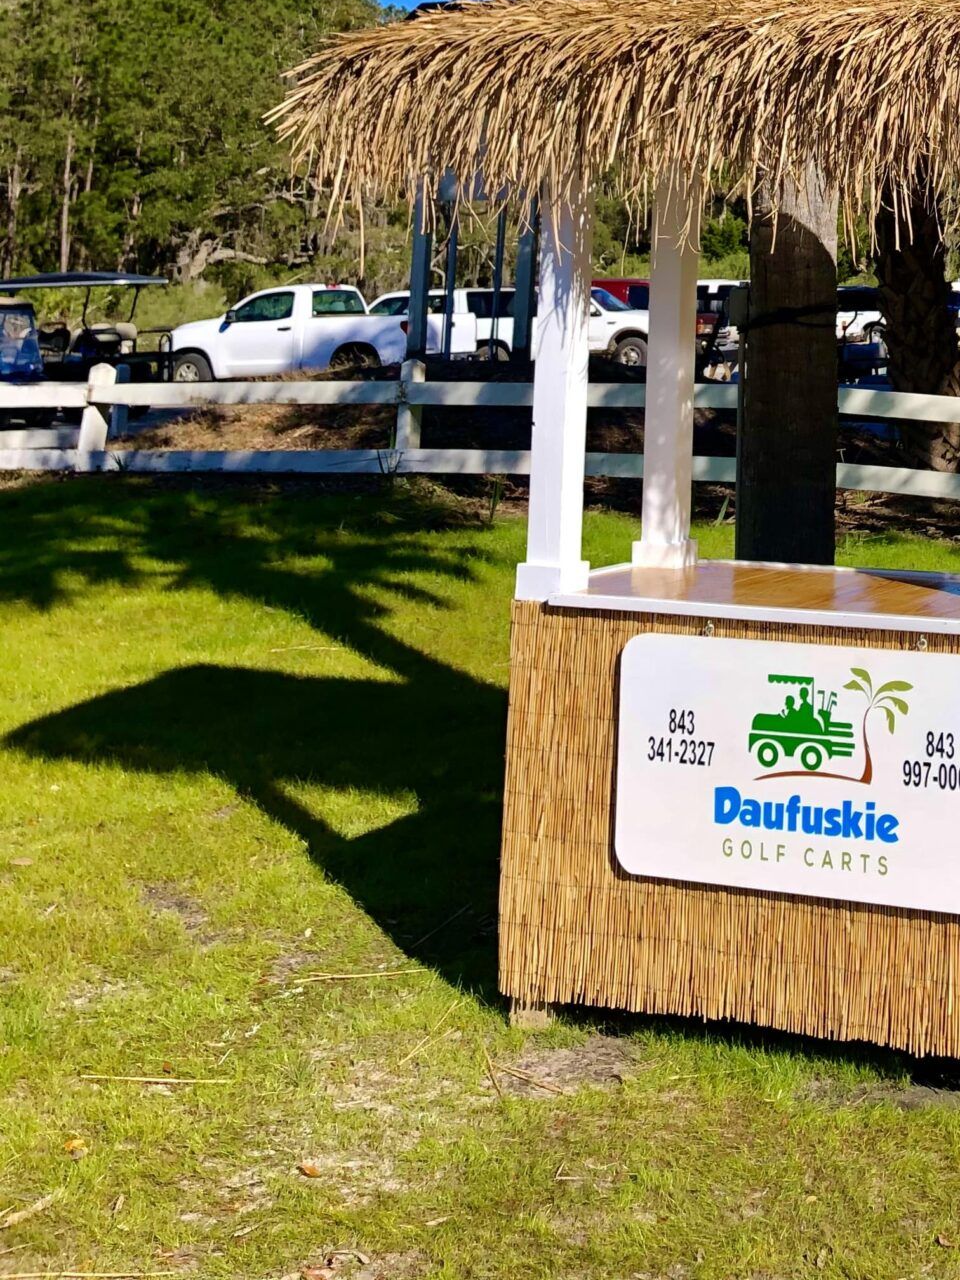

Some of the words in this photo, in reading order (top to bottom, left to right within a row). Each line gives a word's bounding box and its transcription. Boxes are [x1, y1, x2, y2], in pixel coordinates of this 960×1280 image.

[668, 708, 695, 736] 843
[647, 736, 716, 767] 341-2327
[925, 730, 955, 760] 843
[714, 786, 900, 844] Daufuskie
[722, 837, 787, 863] GOLF
[803, 847, 889, 876] CARTS
